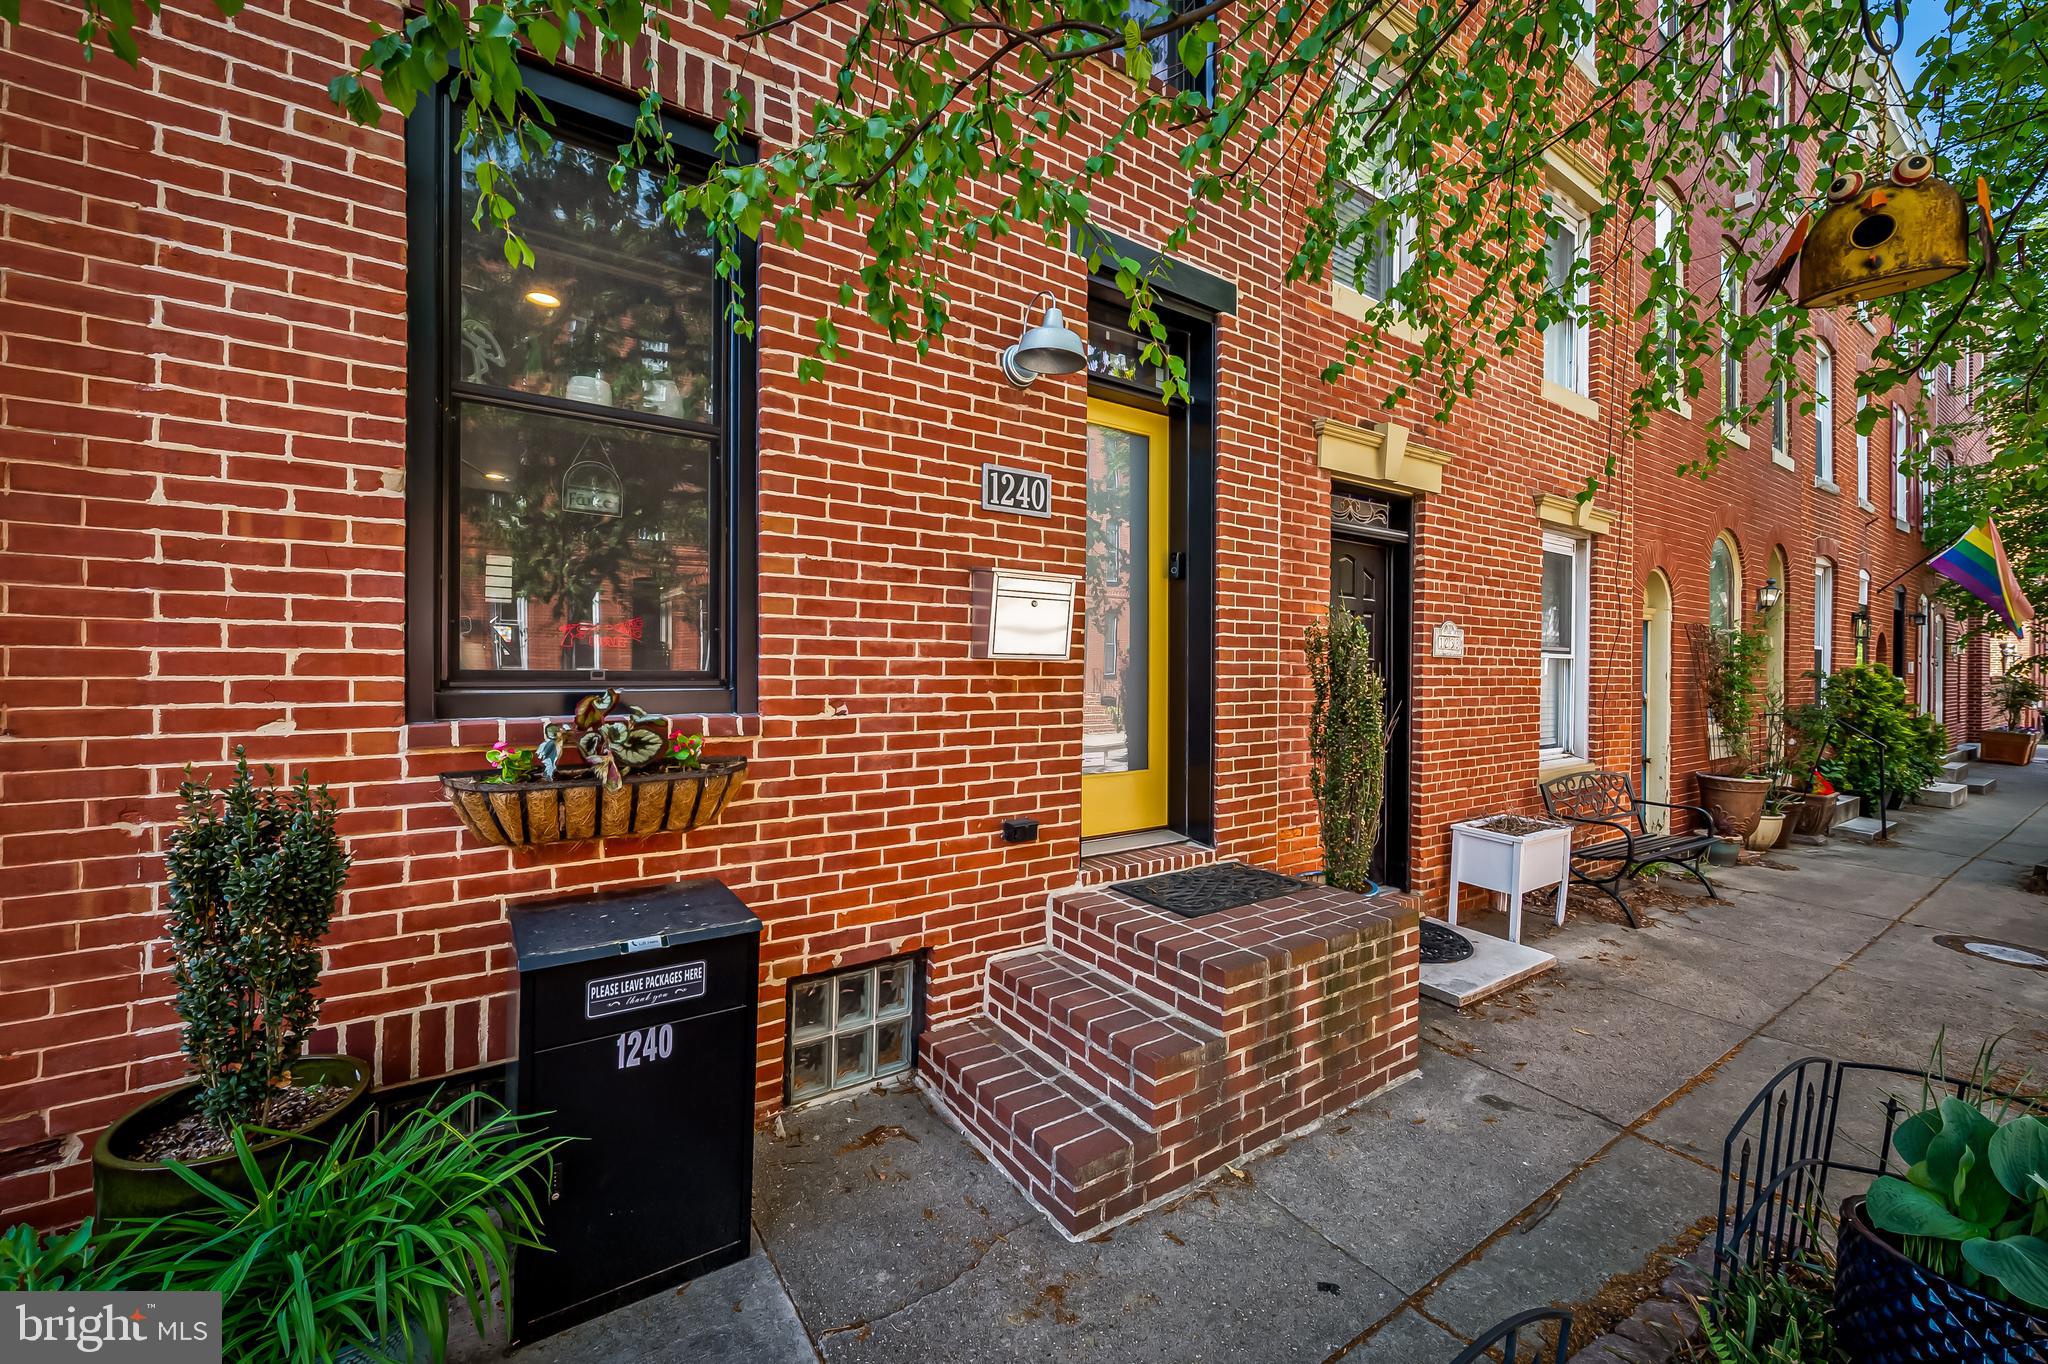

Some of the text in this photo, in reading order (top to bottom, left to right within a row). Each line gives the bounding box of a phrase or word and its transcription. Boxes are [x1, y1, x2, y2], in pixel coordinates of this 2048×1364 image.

[990, 472, 1045, 510] 1240
[591, 967, 703, 1000] PLEASE LEAVE PACKAGES HERE
[625, 992, 669, 1005] thank you
[616, 1023, 673, 1069] 1240
